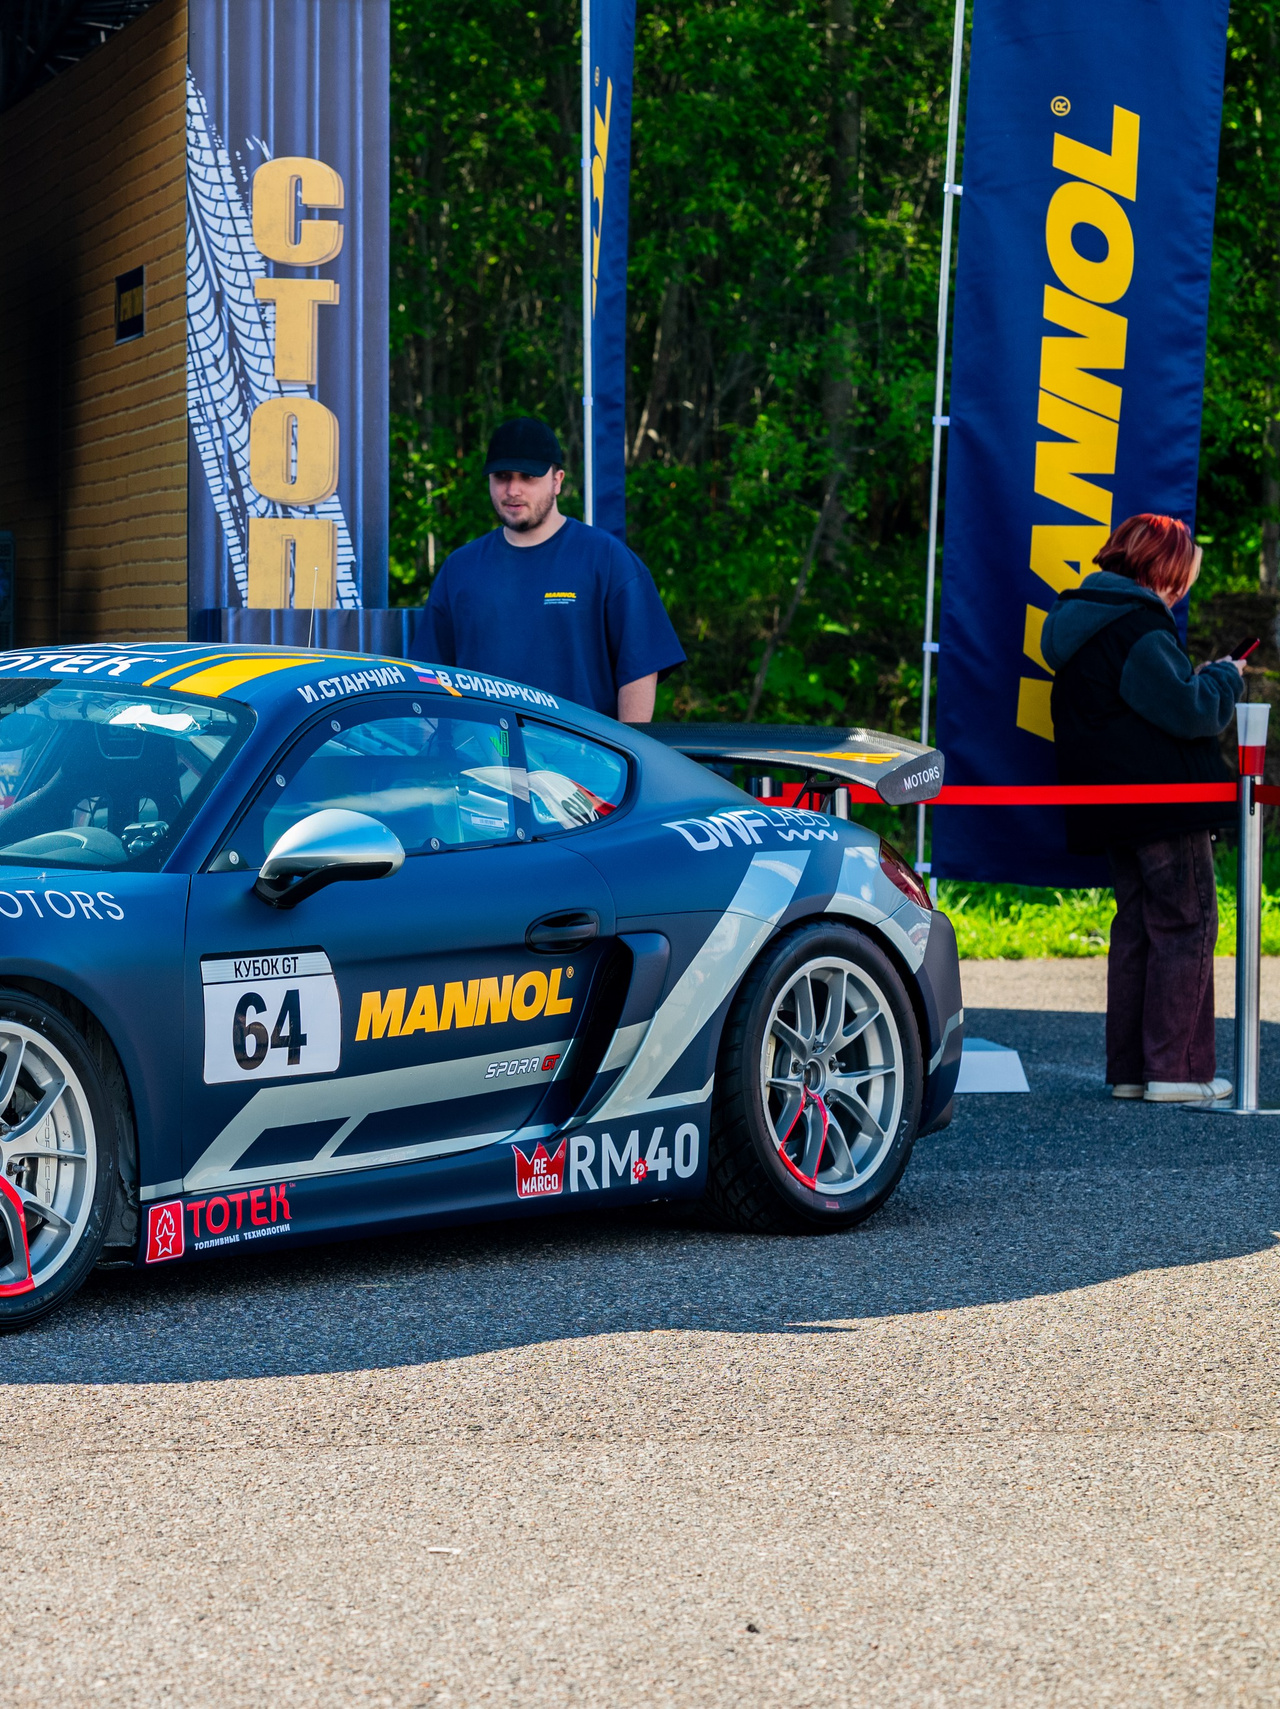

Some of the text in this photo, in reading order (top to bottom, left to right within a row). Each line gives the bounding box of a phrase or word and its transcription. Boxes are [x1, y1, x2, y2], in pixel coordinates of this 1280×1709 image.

[903, 765, 940, 791] MOTORS
[233, 956, 299, 979] КУБОК GT
[232, 988, 308, 1071] 64
[483, 1053, 561, 1080] SPORA GT
[533, 1157, 548, 1175] RE
[521, 1173, 559, 1195] MARCO
[194, 1223, 291, 1251] ТОПЛИВНЫЕ ТЕХНОЛОГИИ
